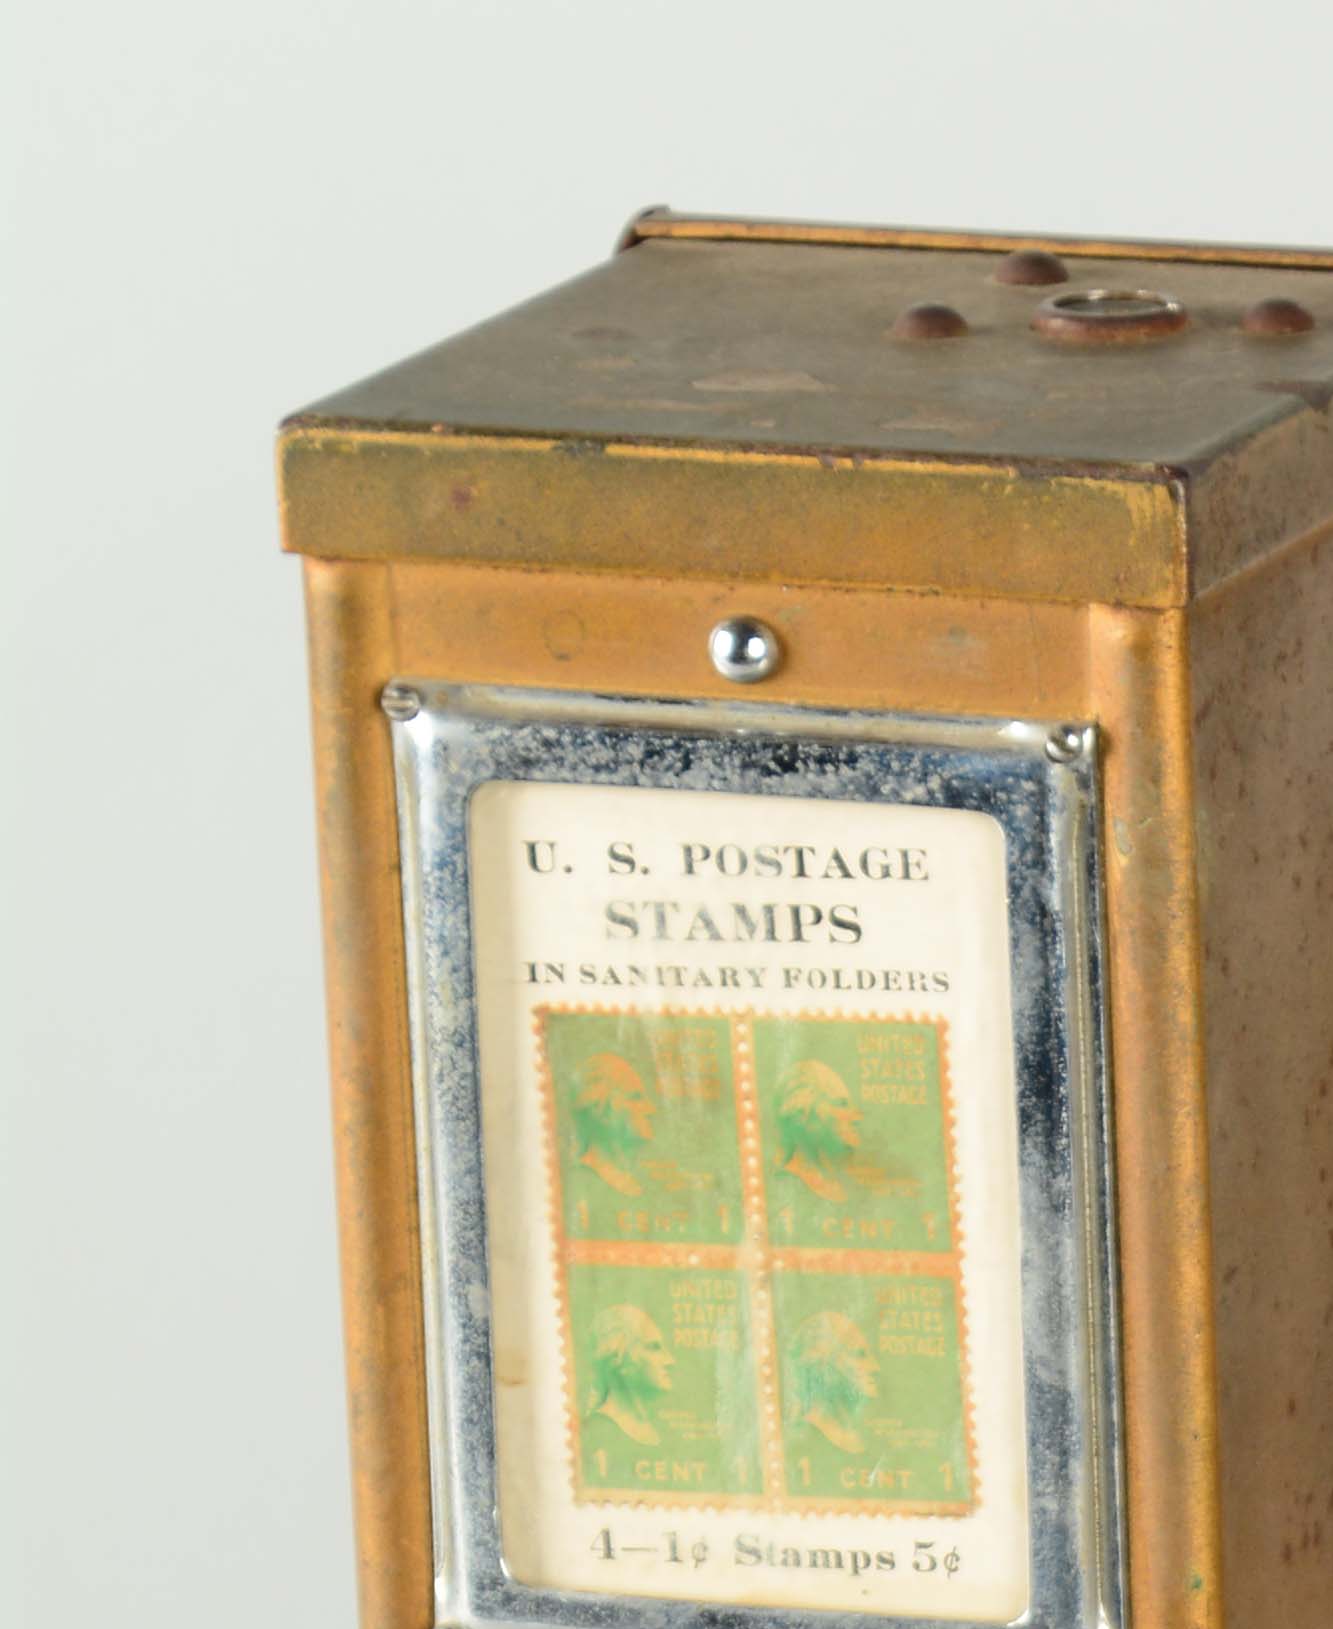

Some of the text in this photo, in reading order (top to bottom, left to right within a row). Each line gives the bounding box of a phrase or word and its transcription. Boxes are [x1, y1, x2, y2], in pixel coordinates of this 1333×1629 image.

[523, 840, 929, 881] U. S. POSTAGE
[605, 900, 863, 944] STAMPS
[523, 961, 950, 993] IN SANITARY FOLDERS
[635, 1459, 706, 1481] CENT
[733, 1533, 896, 1576] Stamps
[912, 1541, 961, 1578] 5¢
